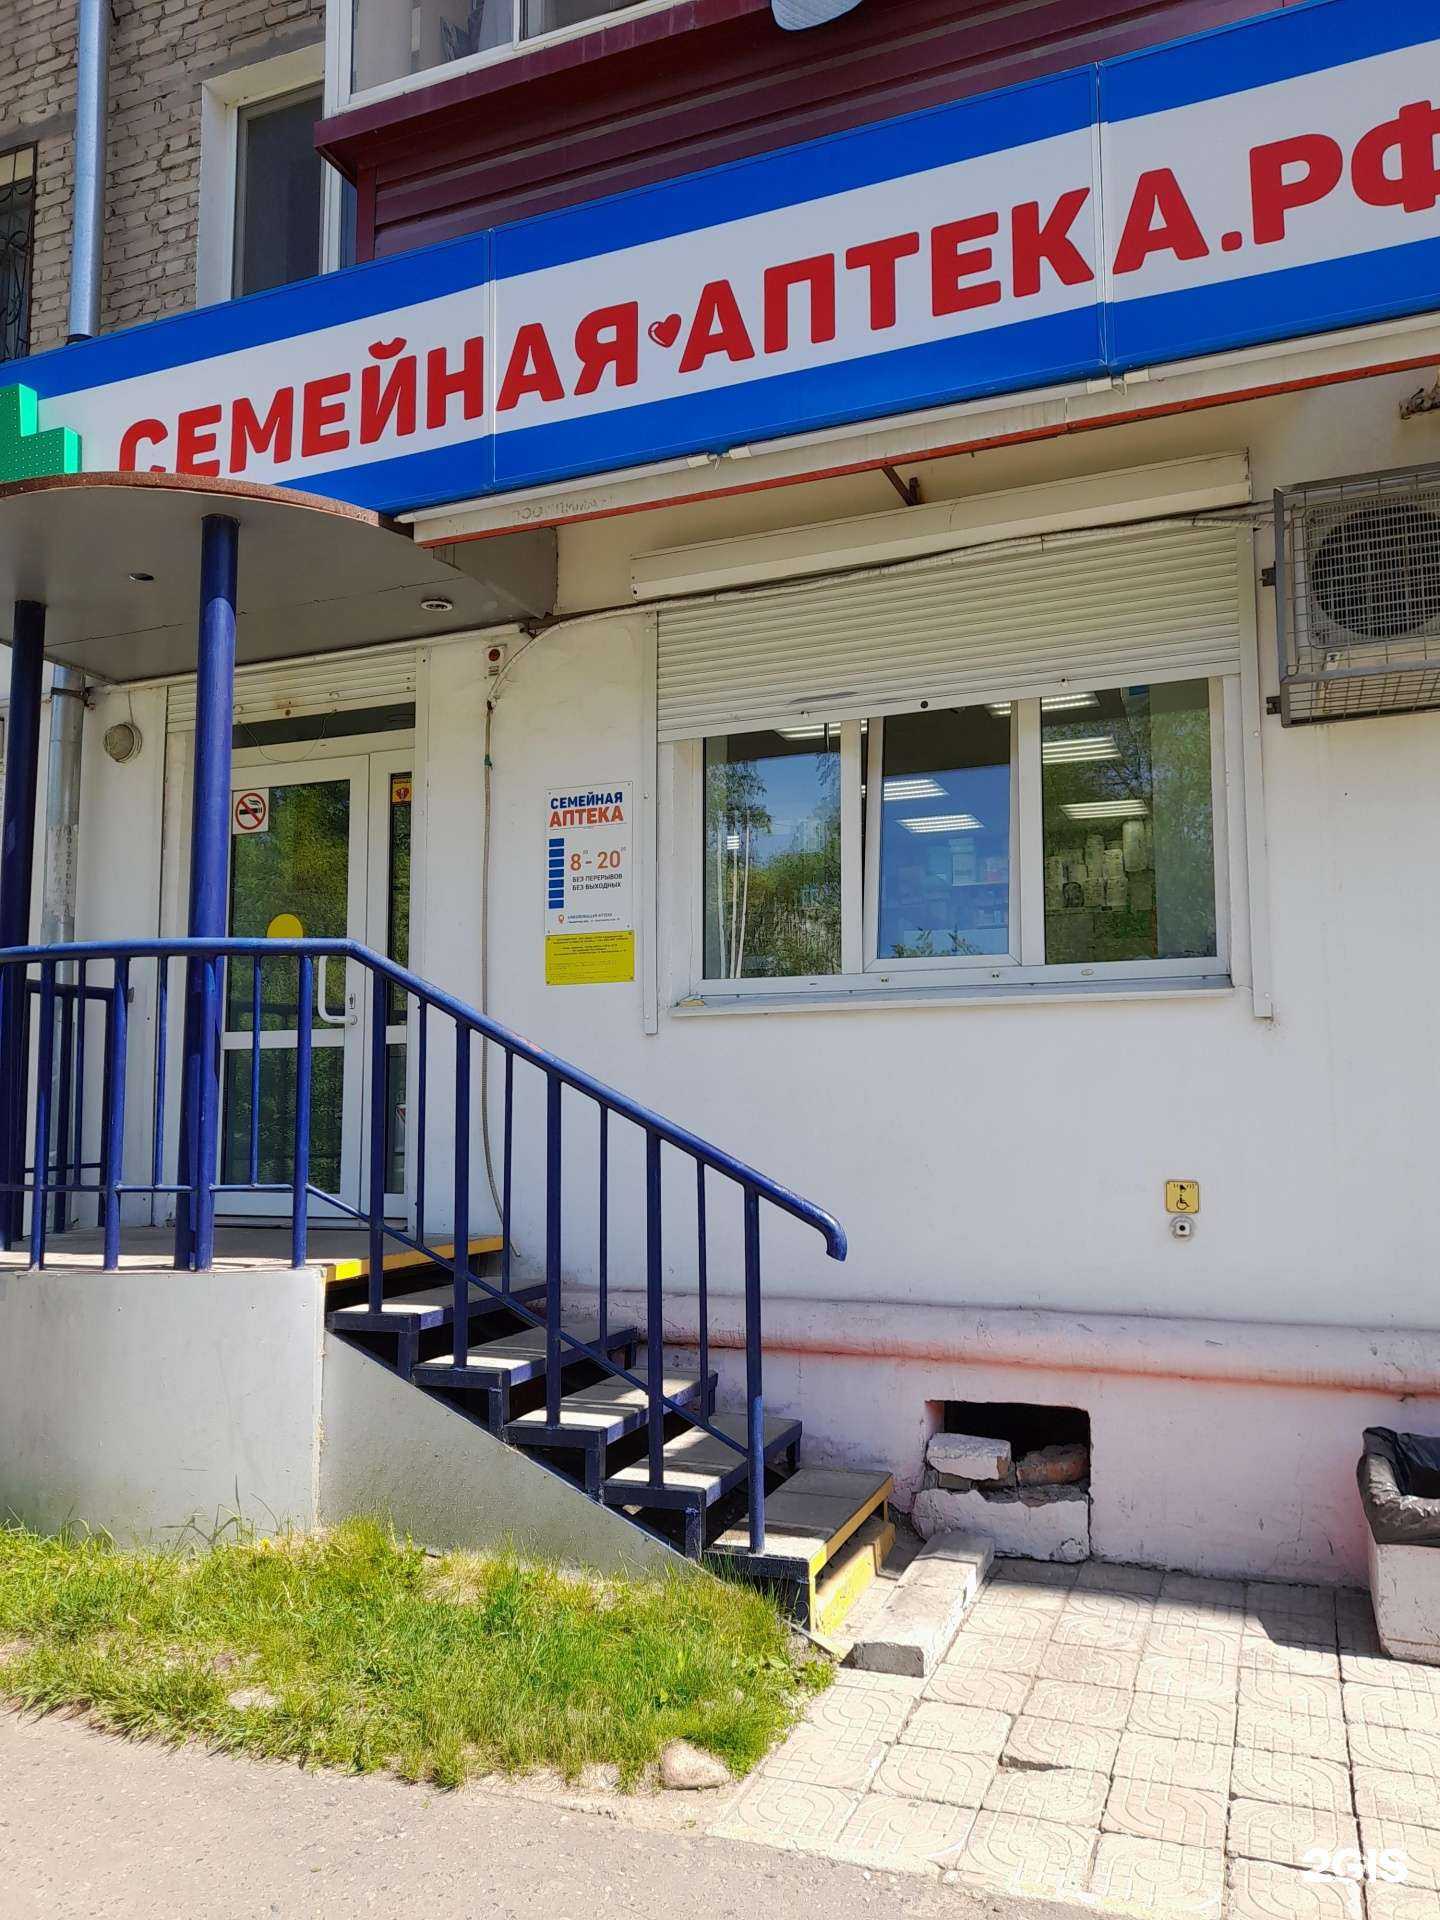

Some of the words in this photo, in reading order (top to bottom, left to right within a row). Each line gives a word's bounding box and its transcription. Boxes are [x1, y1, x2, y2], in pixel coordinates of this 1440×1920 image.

[119, 300, 639, 477] СЕМЕЙНАЯ
[679, 100, 1440, 373] АПТЕКА.РФ
[551, 791, 623, 809] СЕМЕЙНАЯ
[549, 806, 624, 827] АПТЕКА
[585, 873, 623, 882] ПЕРЕРЫВОВ
[585, 881, 622, 890] ВЫХОДНЫХ
